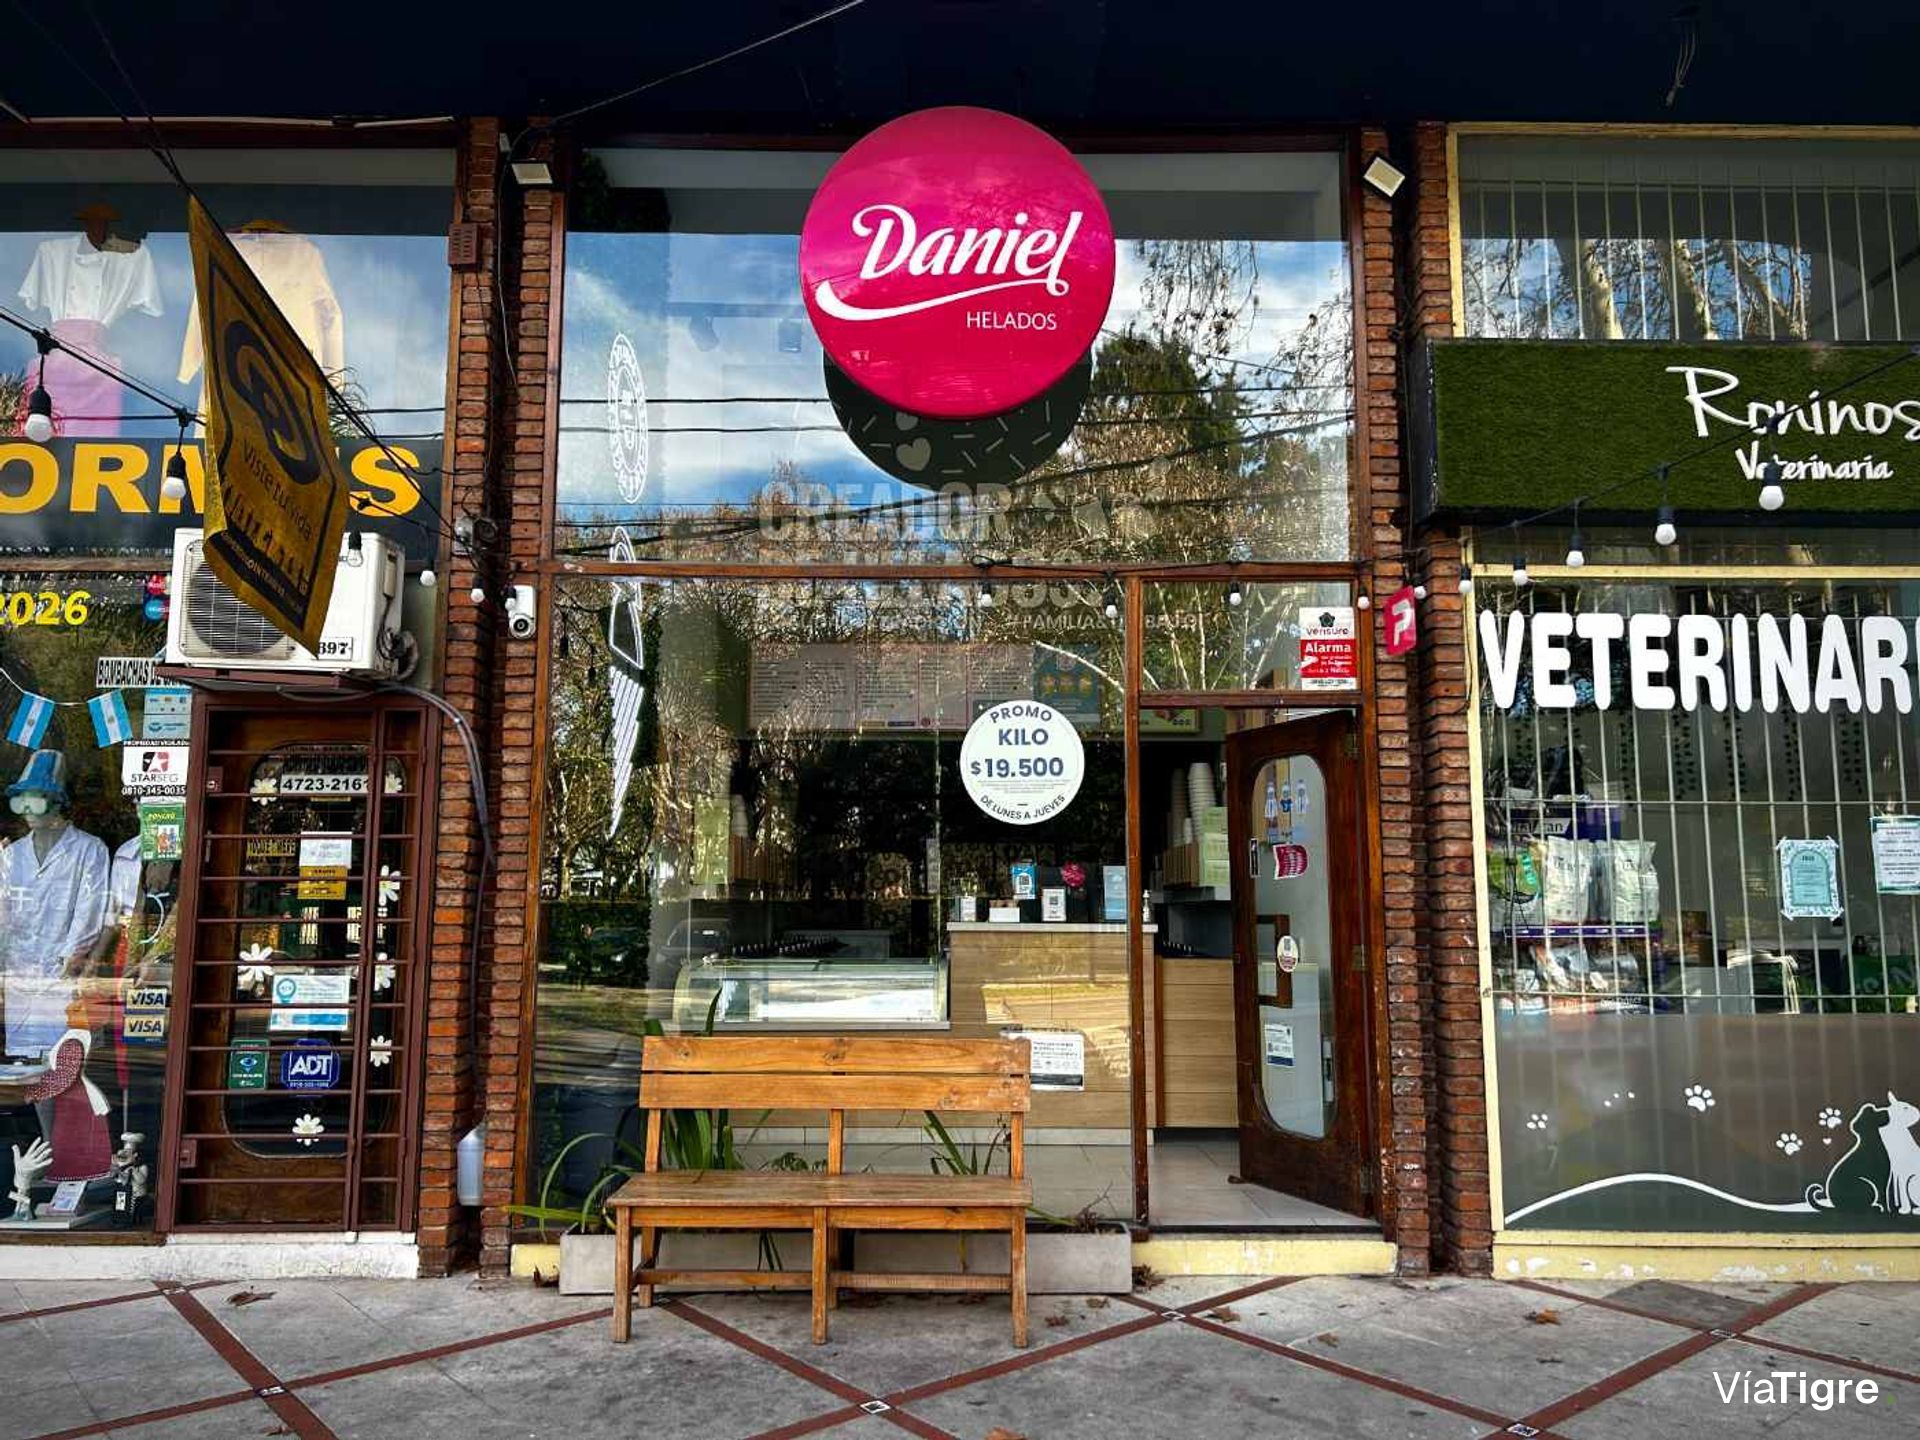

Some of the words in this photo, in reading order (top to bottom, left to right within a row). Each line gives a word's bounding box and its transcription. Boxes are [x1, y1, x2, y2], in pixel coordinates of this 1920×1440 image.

[851, 204, 1083, 297] Daniel
[966, 311, 1058, 331] HELADOS
[0, 590, 91, 626] 026
[1305, 641, 1351, 653] Alarma
[1479, 610, 1920, 715] VETERINAR
[990, 705, 1052, 723] PROMO
[998, 728, 1048, 746] KILO
[970, 757, 1064, 778] $19.500
[980, 795, 991, 808] DE
[992, 803, 1022, 820] LUNES
[1023, 811, 1031, 819] A
[1033, 794, 1066, 818] JUEVES
[131, 992, 164, 1005] VISA
[128, 1020, 162, 1033] VISA
[290, 1054, 331, 1075] ADT
